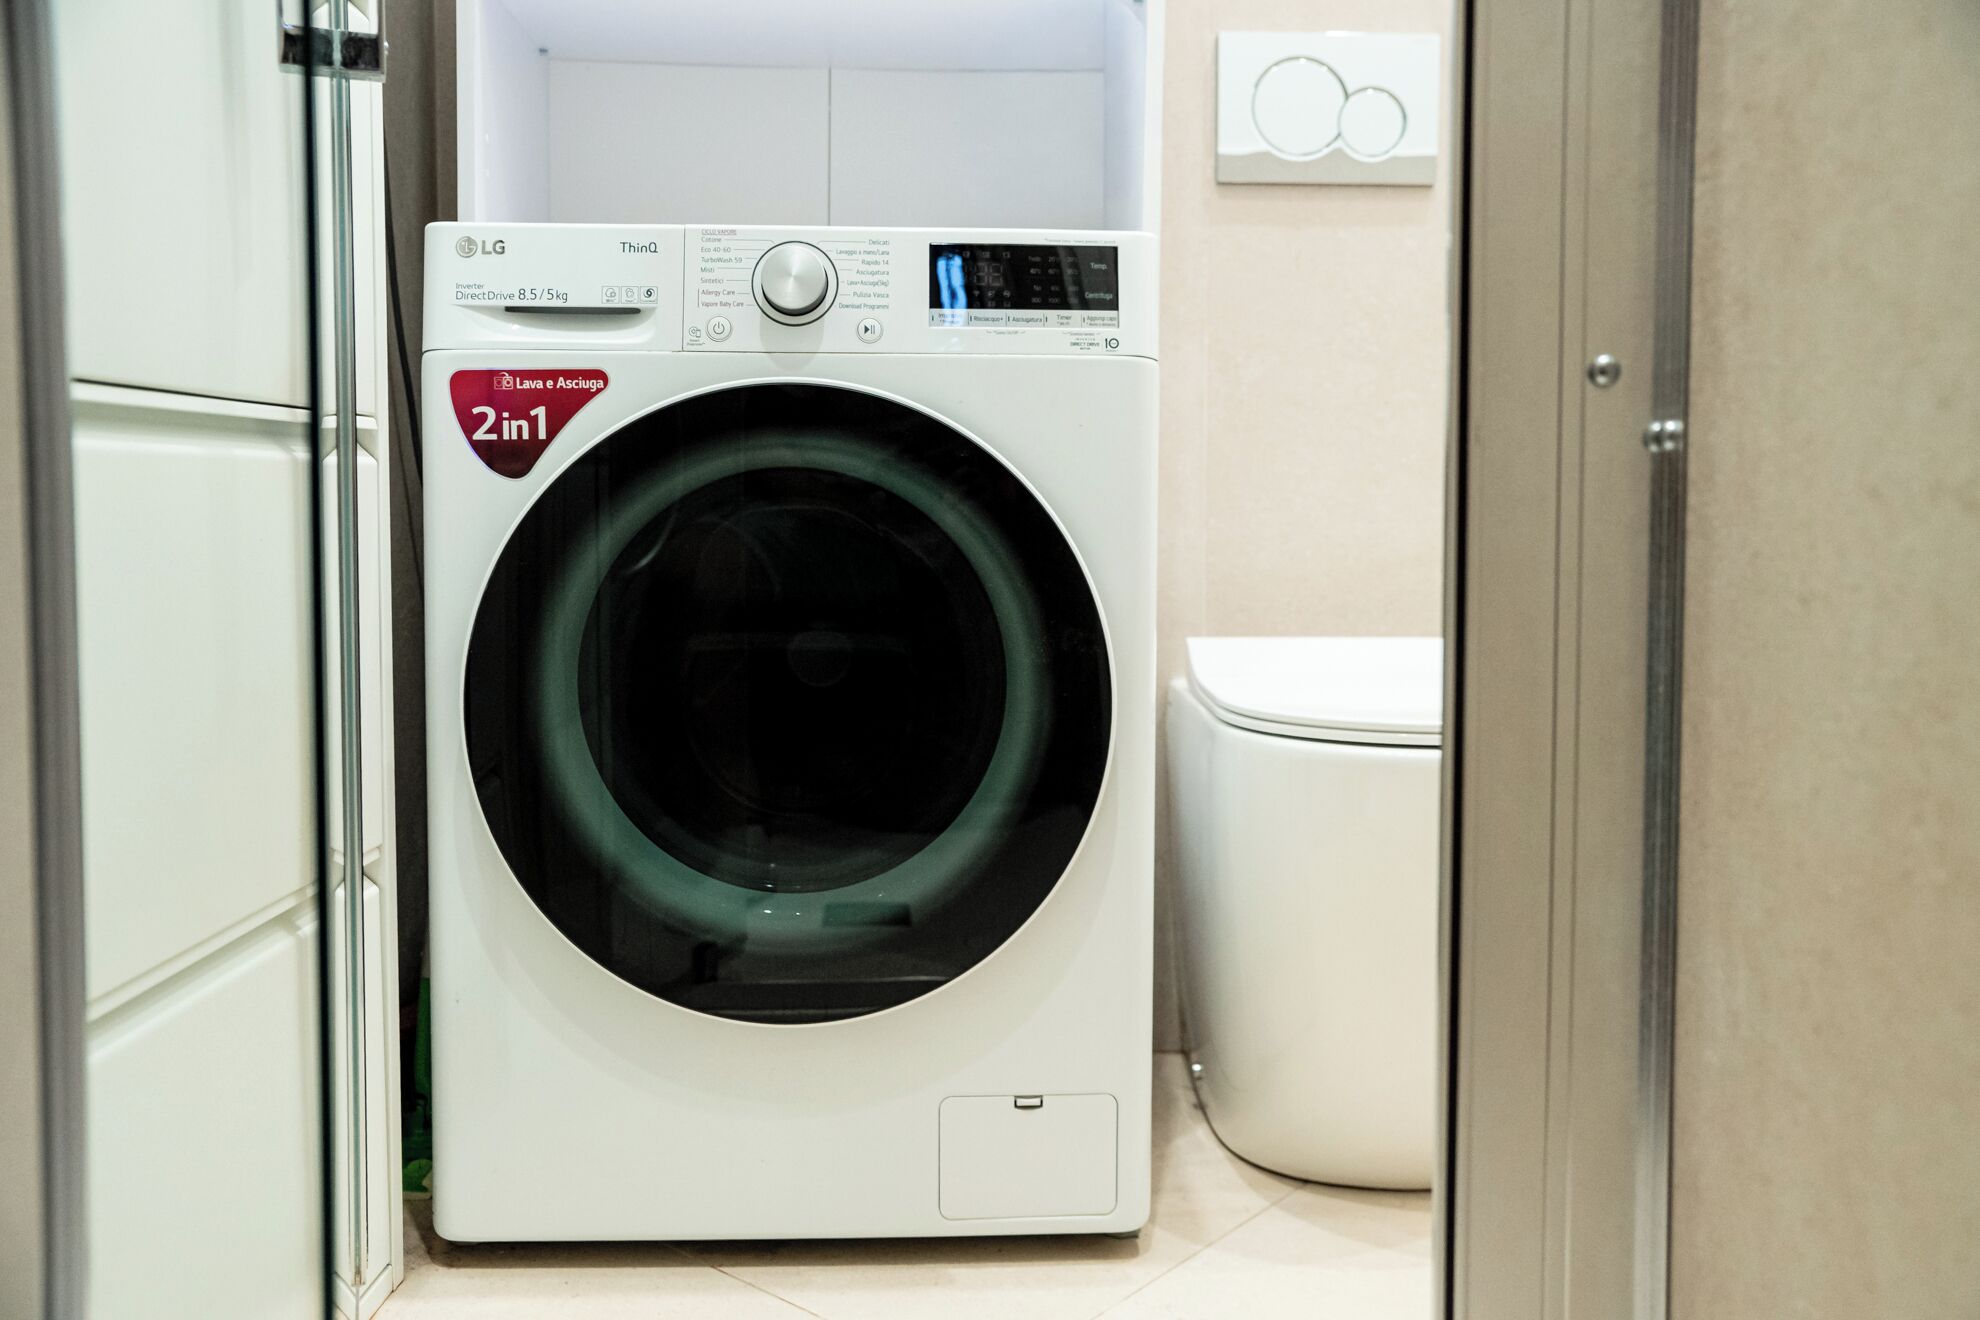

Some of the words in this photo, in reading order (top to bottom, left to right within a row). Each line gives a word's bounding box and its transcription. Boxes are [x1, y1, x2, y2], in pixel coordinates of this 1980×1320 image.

[481, 240, 506, 255] LG
[620, 241, 658, 254] ThinQ
[455, 282, 485, 290] Inverter
[516, 377, 544, 389] Lava
[546, 380, 554, 389] e
[556, 377, 605, 392] Asciuga
